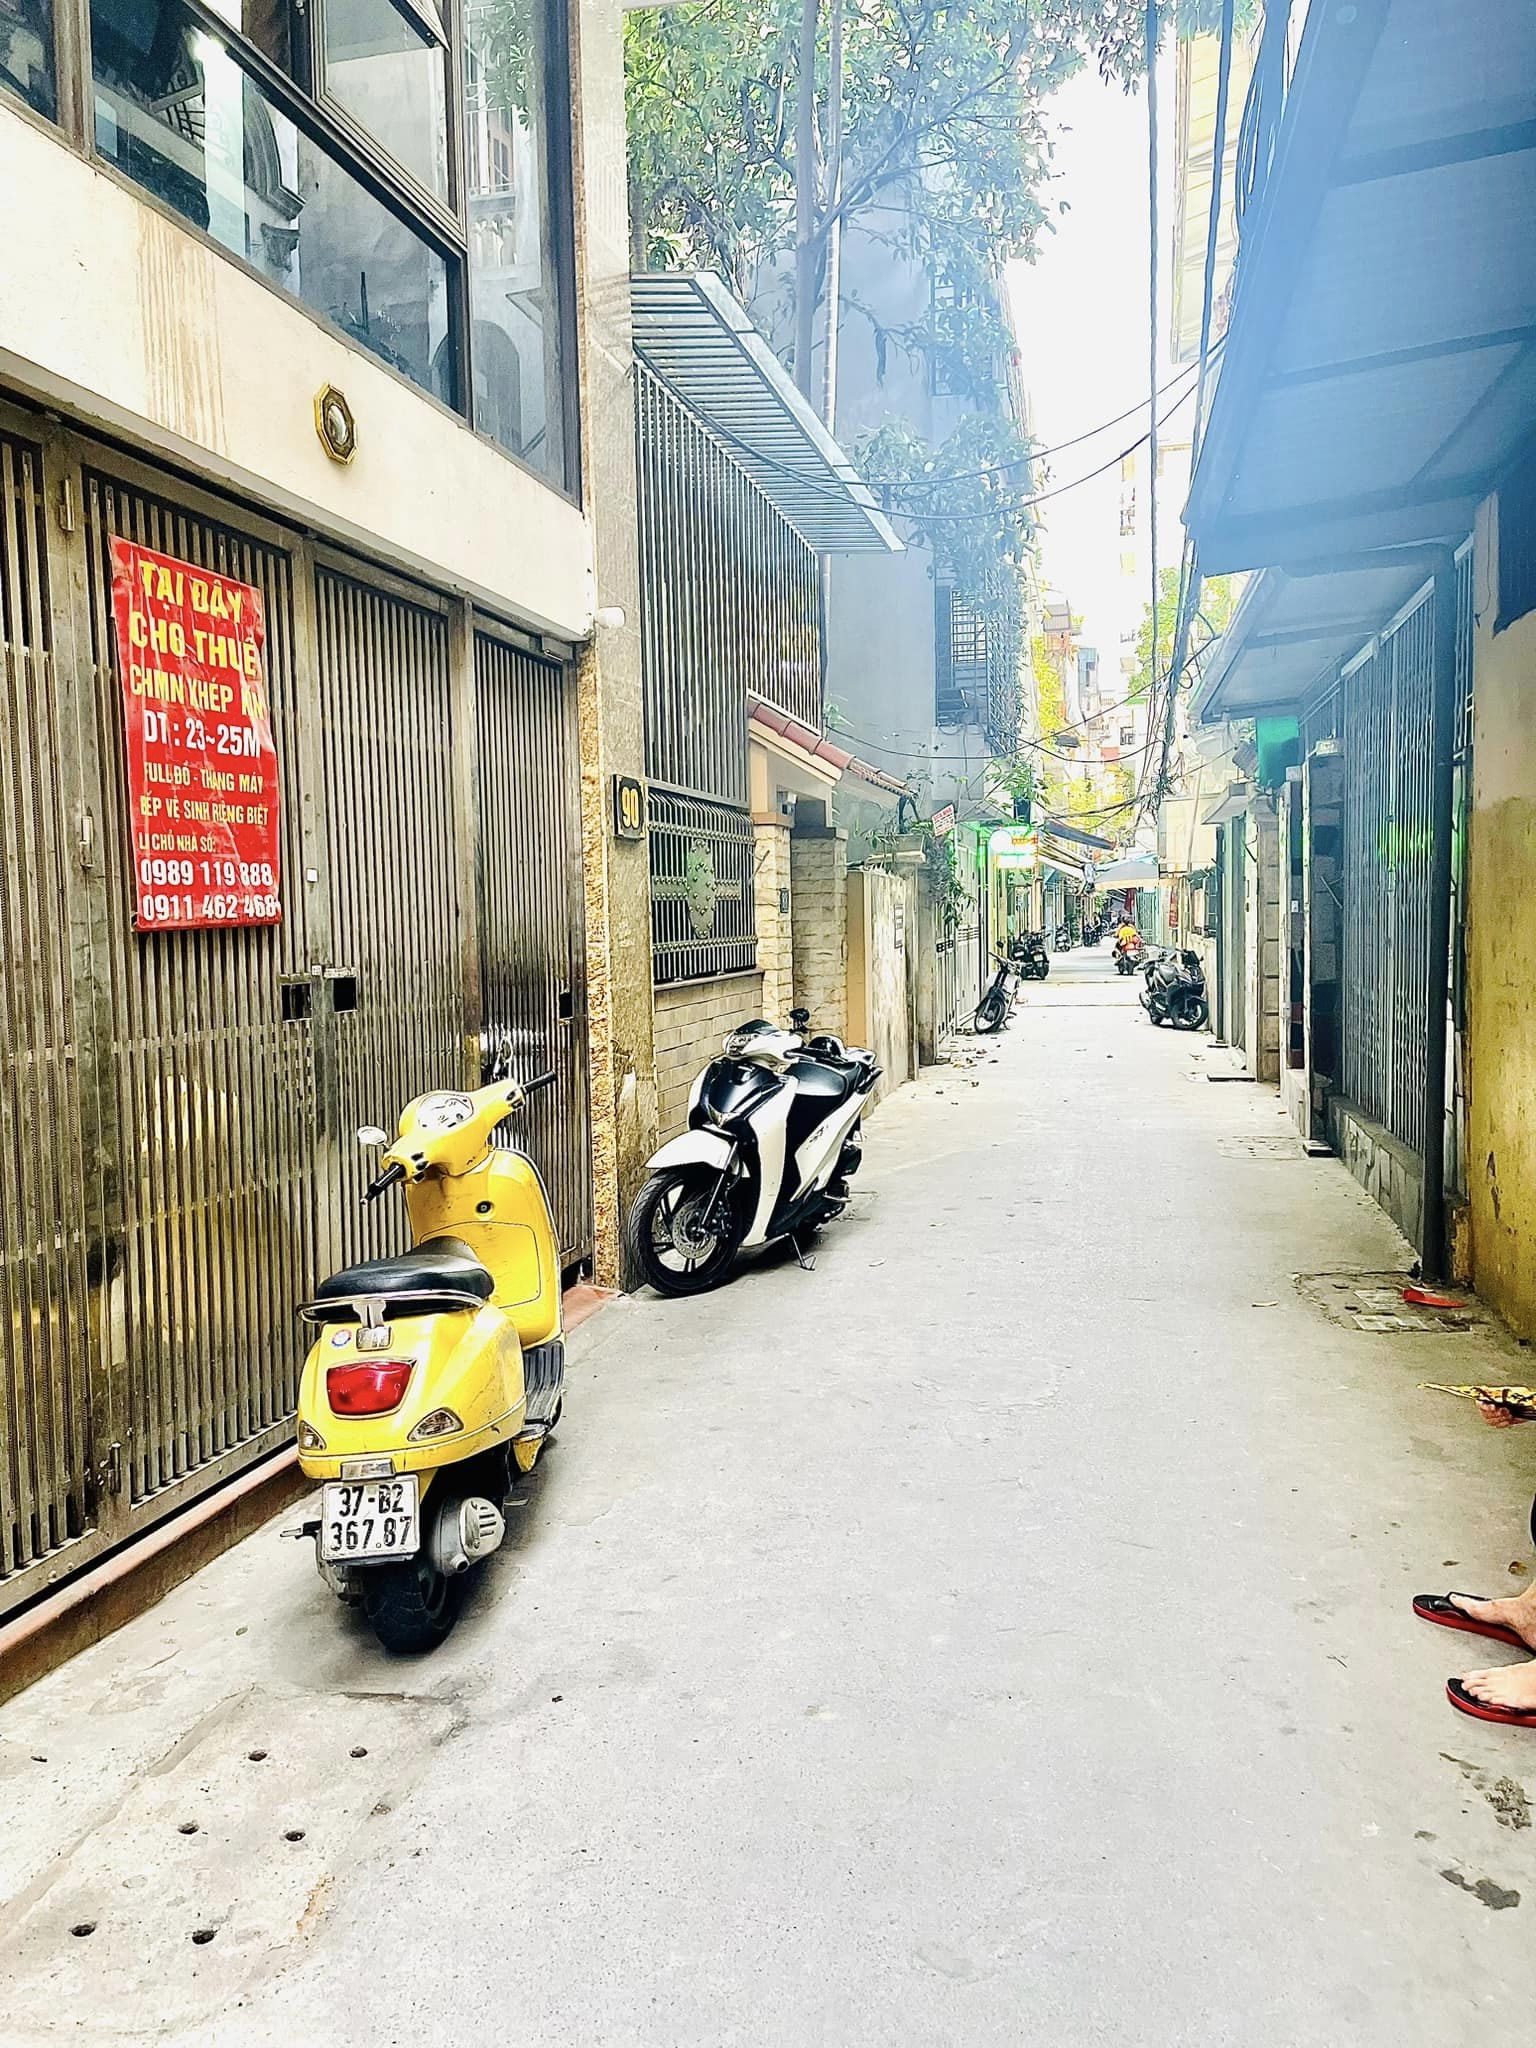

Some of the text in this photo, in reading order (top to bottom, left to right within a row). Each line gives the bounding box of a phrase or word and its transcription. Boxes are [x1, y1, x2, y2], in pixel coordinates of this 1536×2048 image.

[139, 560, 242, 624] TẠI ĐÂY
[193, 630, 258, 677] THUÊ
[129, 664, 185, 705] CHMN
[239, 772, 264, 795] MÁY
[165, 794, 180, 822] VỆ
[183, 800, 210, 821] SINH
[622, 786, 639, 829] 90
[152, 829, 175, 851] CHỦ
[140, 859, 273, 887] 0989 119 888
[143, 894, 193, 920] 0911
[202, 894, 238, 919] 462
[339, 1483, 404, 1516] 37-B2
